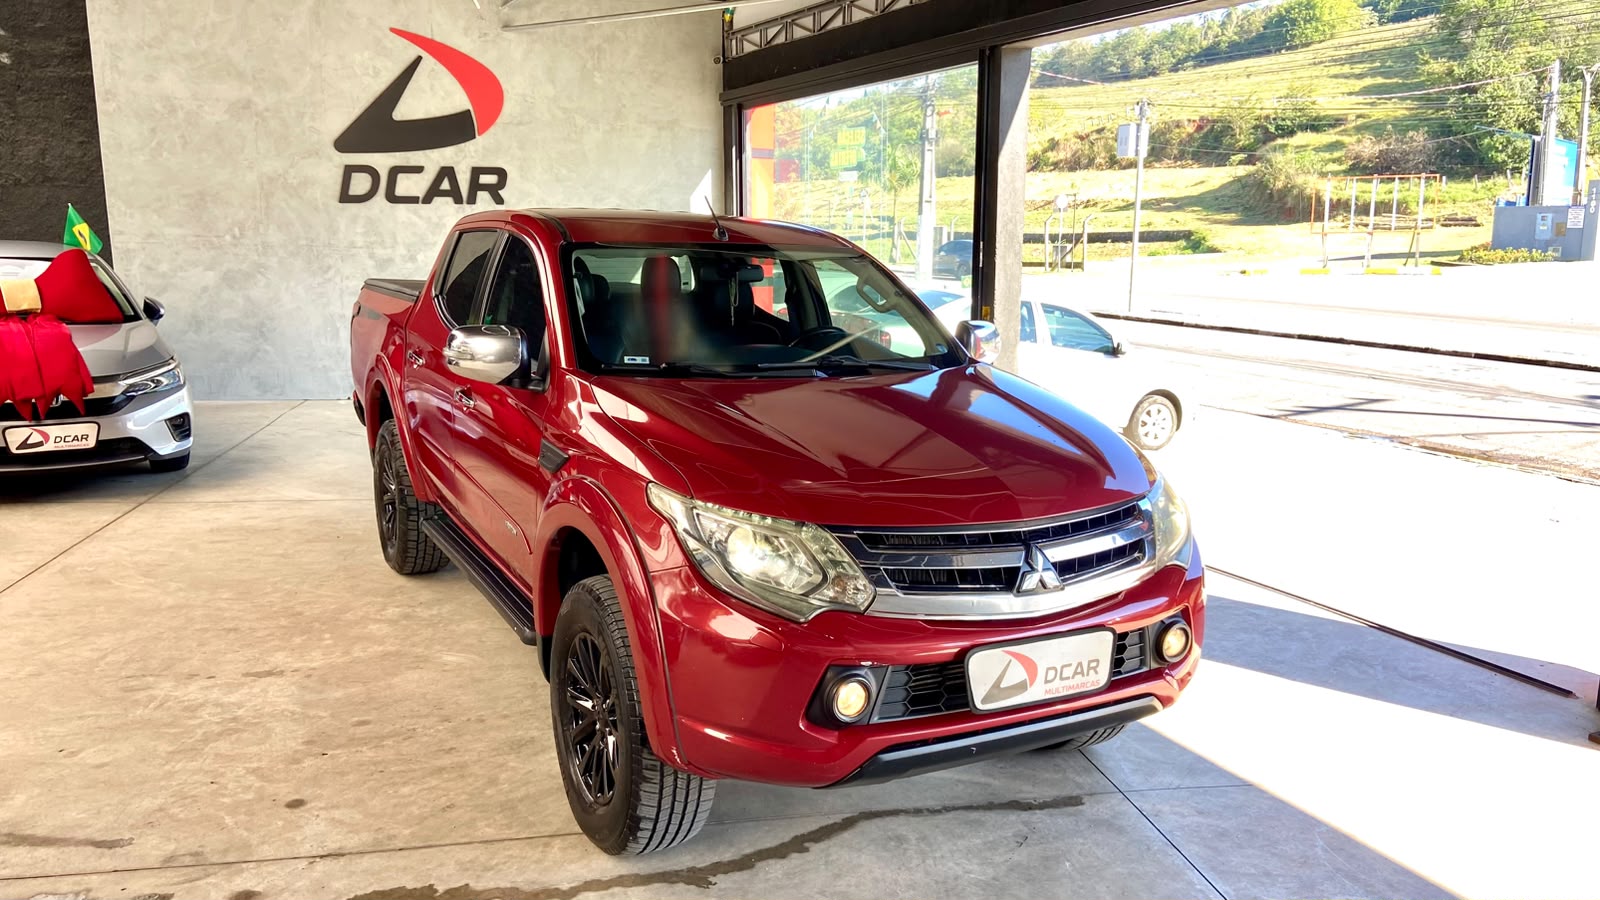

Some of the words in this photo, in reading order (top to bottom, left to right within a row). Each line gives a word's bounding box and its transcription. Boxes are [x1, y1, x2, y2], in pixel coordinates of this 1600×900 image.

[338, 164, 508, 205] DCAR
[54, 434, 89, 443] DCAR
[1044, 658, 1100, 684] DCAR
[1044, 679, 1100, 695] MULTIMARCAS
